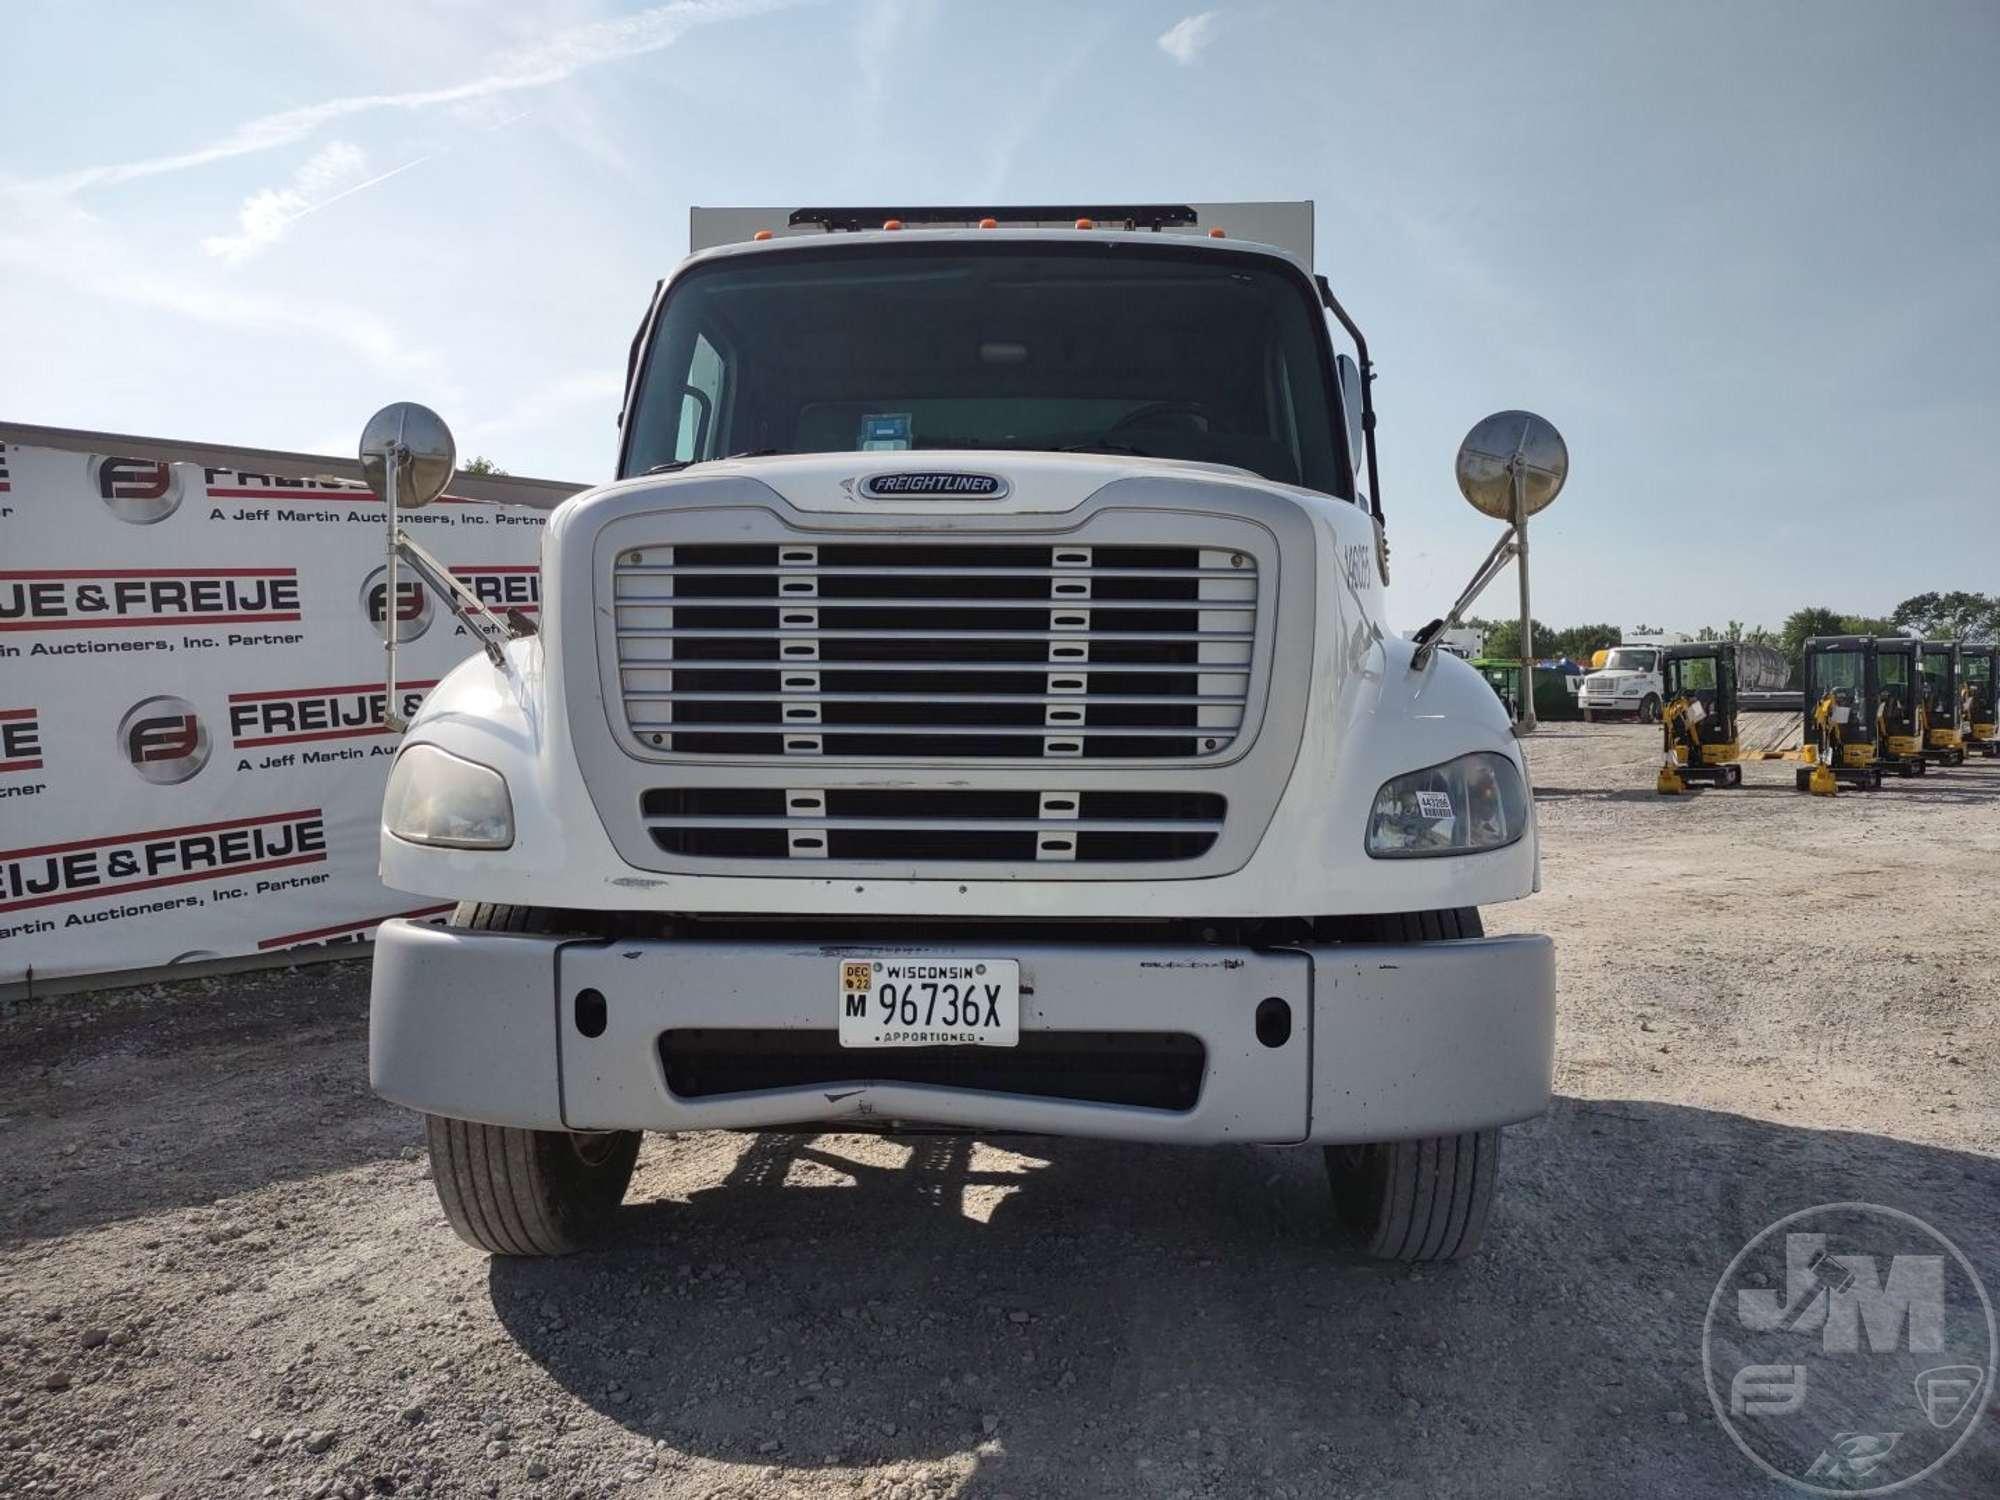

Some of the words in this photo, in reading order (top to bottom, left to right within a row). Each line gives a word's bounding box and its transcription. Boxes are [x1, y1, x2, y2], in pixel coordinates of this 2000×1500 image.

[875, 476, 993, 491] FREIGHTLINER
[210, 508, 225, 520] A
[233, 509, 271, 521] Jeff
[277, 510, 340, 522] Martin
[347, 511, 455, 526] Auctoneers,
[461, 513, 489, 524] Inc.
[496, 513, 547, 525] Partne
[450, 576, 539, 603] FREI
[30, 640, 175, 656] Auctioneers,
[183, 636, 220, 648] Inc.
[228, 633, 304, 646] Partner
[236, 759, 253, 771] A
[259, 753, 296, 769] Jeff
[303, 748, 364, 765] Martin
[64, 895, 205, 928] Auctioneers,
[213, 887, 248, 901] Inc.
[256, 873, 330, 894] Partner
[847, 966, 868, 977] DEC
[887, 966, 973, 979] WISCONSIN
[846, 994, 866, 1017] M
[879, 983, 1001, 1027] 96736X
[884, 1032, 975, 1043] APPORTIONED
